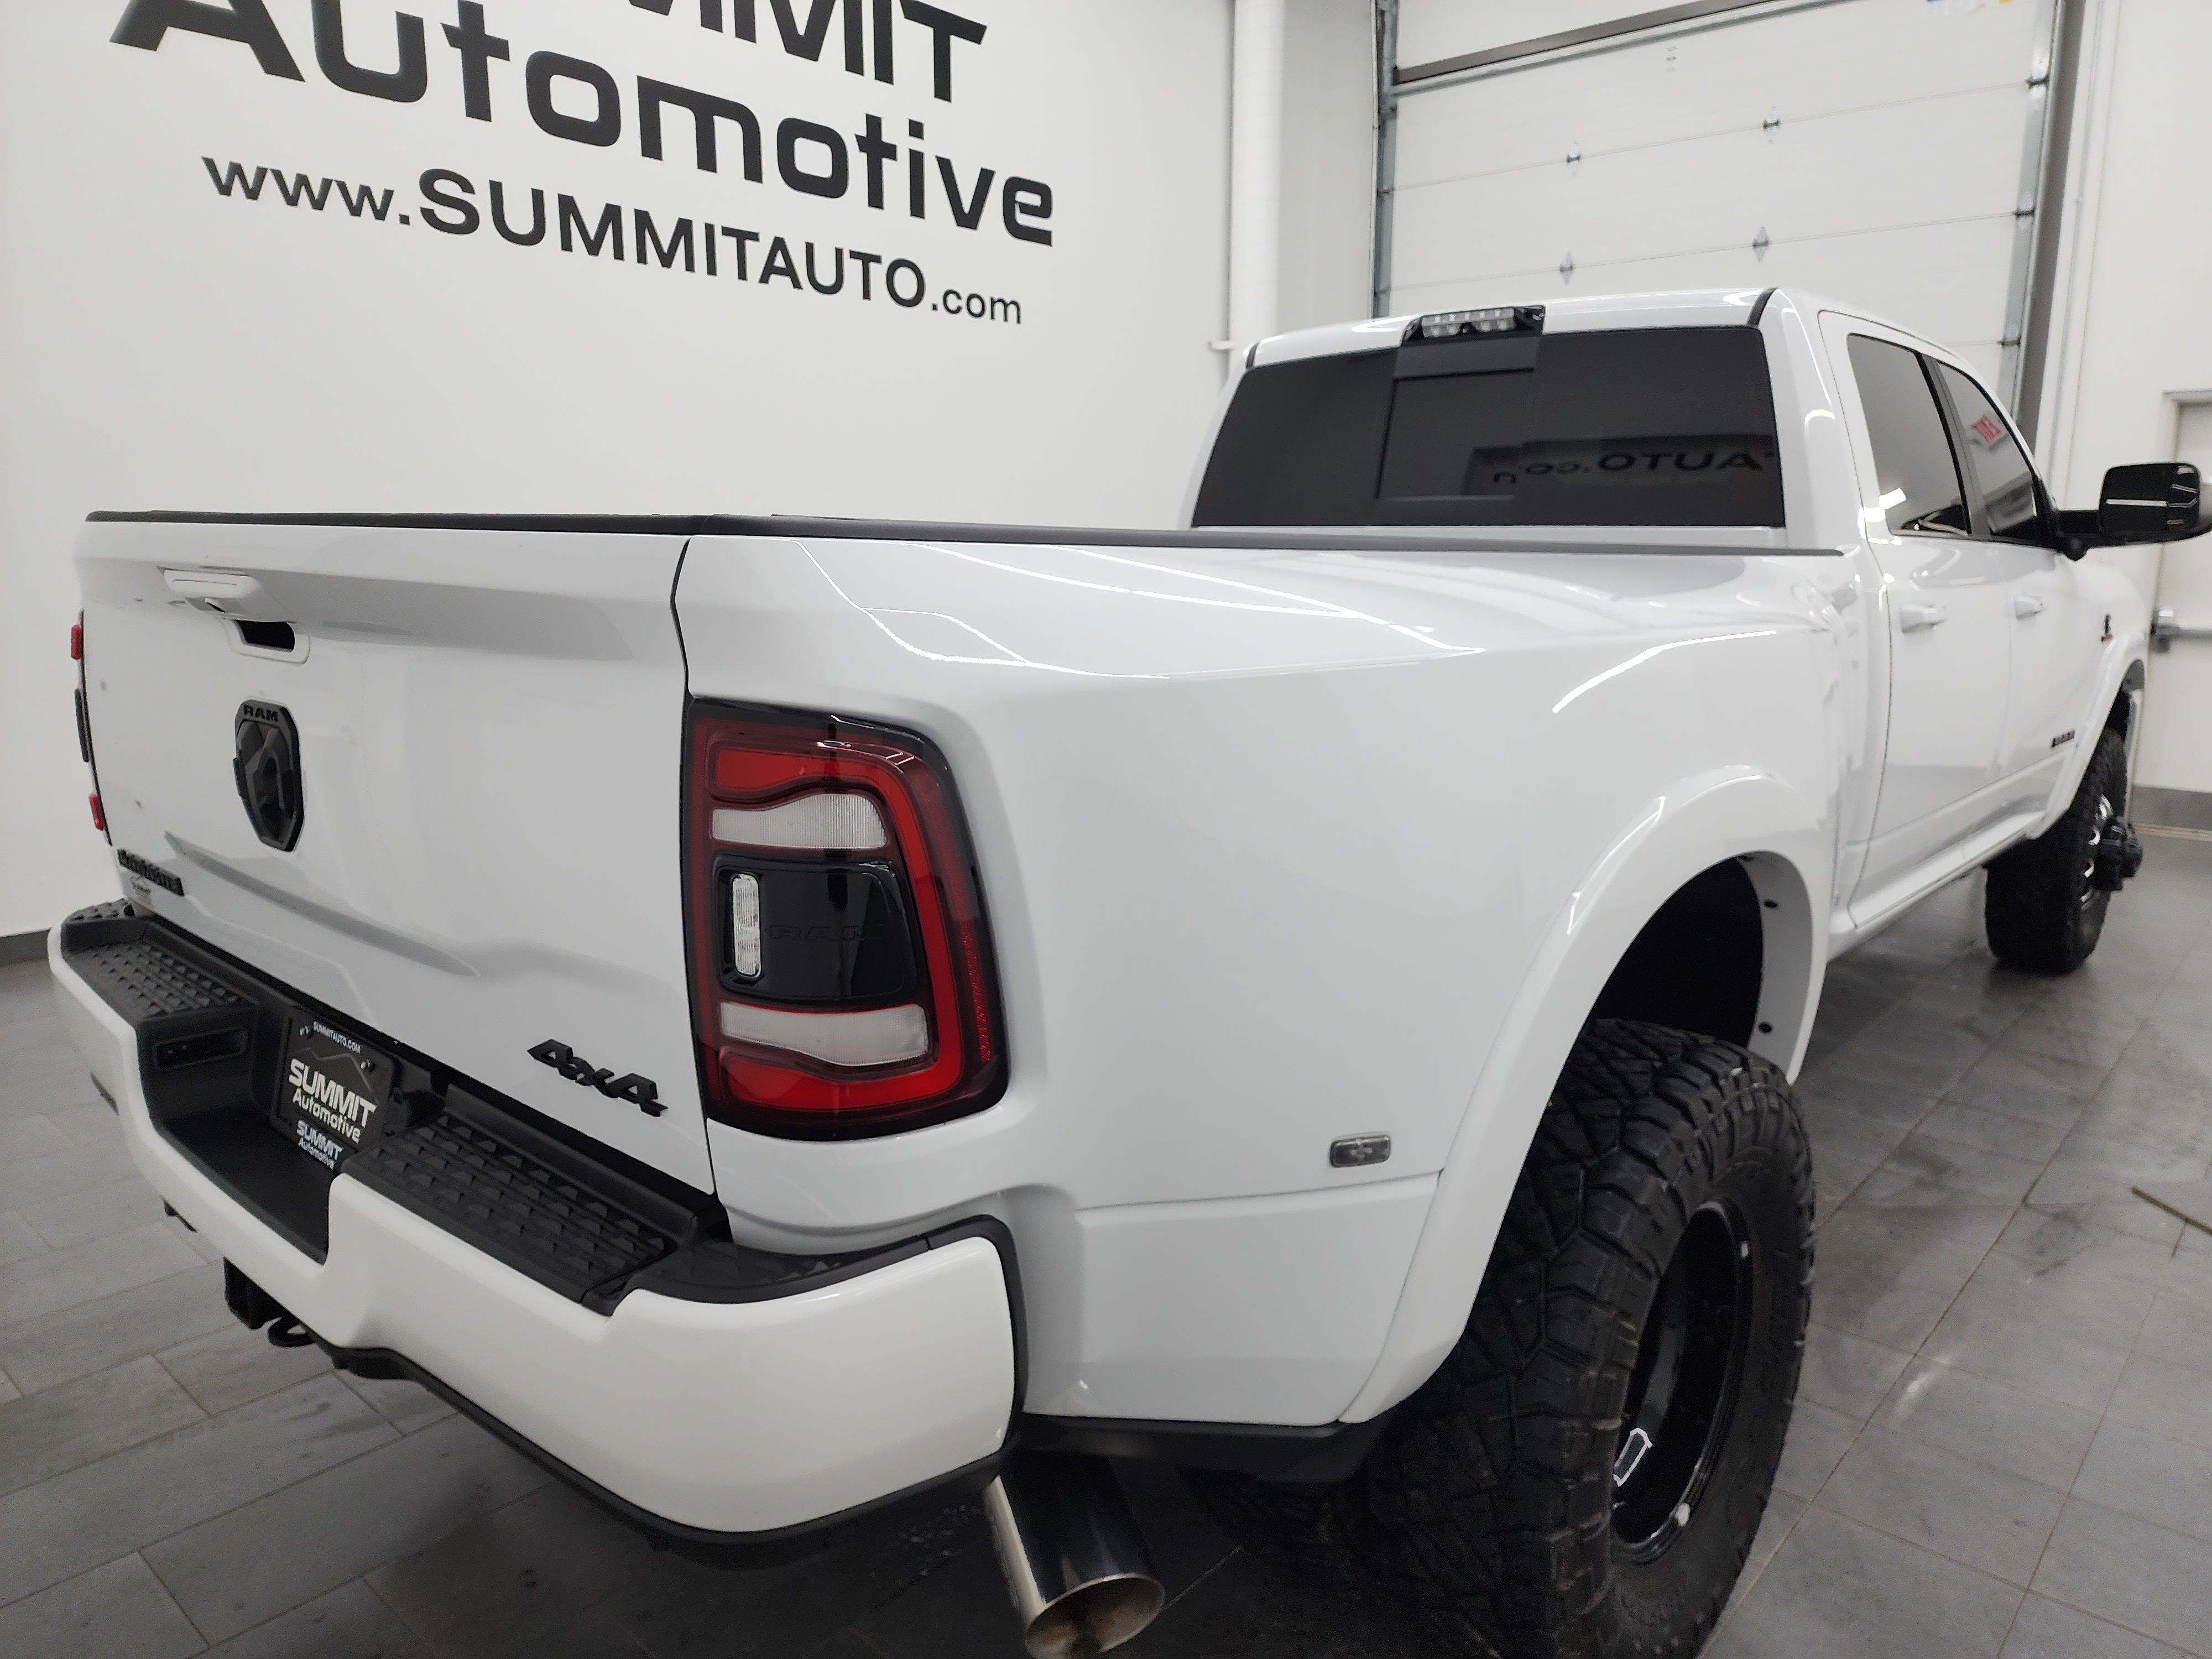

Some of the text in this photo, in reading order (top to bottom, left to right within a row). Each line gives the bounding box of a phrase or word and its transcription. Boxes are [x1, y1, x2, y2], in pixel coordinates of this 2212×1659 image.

[629, 0, 988, 103] MIT
[202, 156, 1021, 325] www.SUMMITAUTO.com
[243, 704, 278, 722] RAM
[313, 1021, 361, 1054] SUMMITAUTO.COM
[289, 1058, 378, 1128] SUMMIT
[292, 1087, 362, 1144] Automotive
[296, 1119, 345, 1161] SUMMIT
